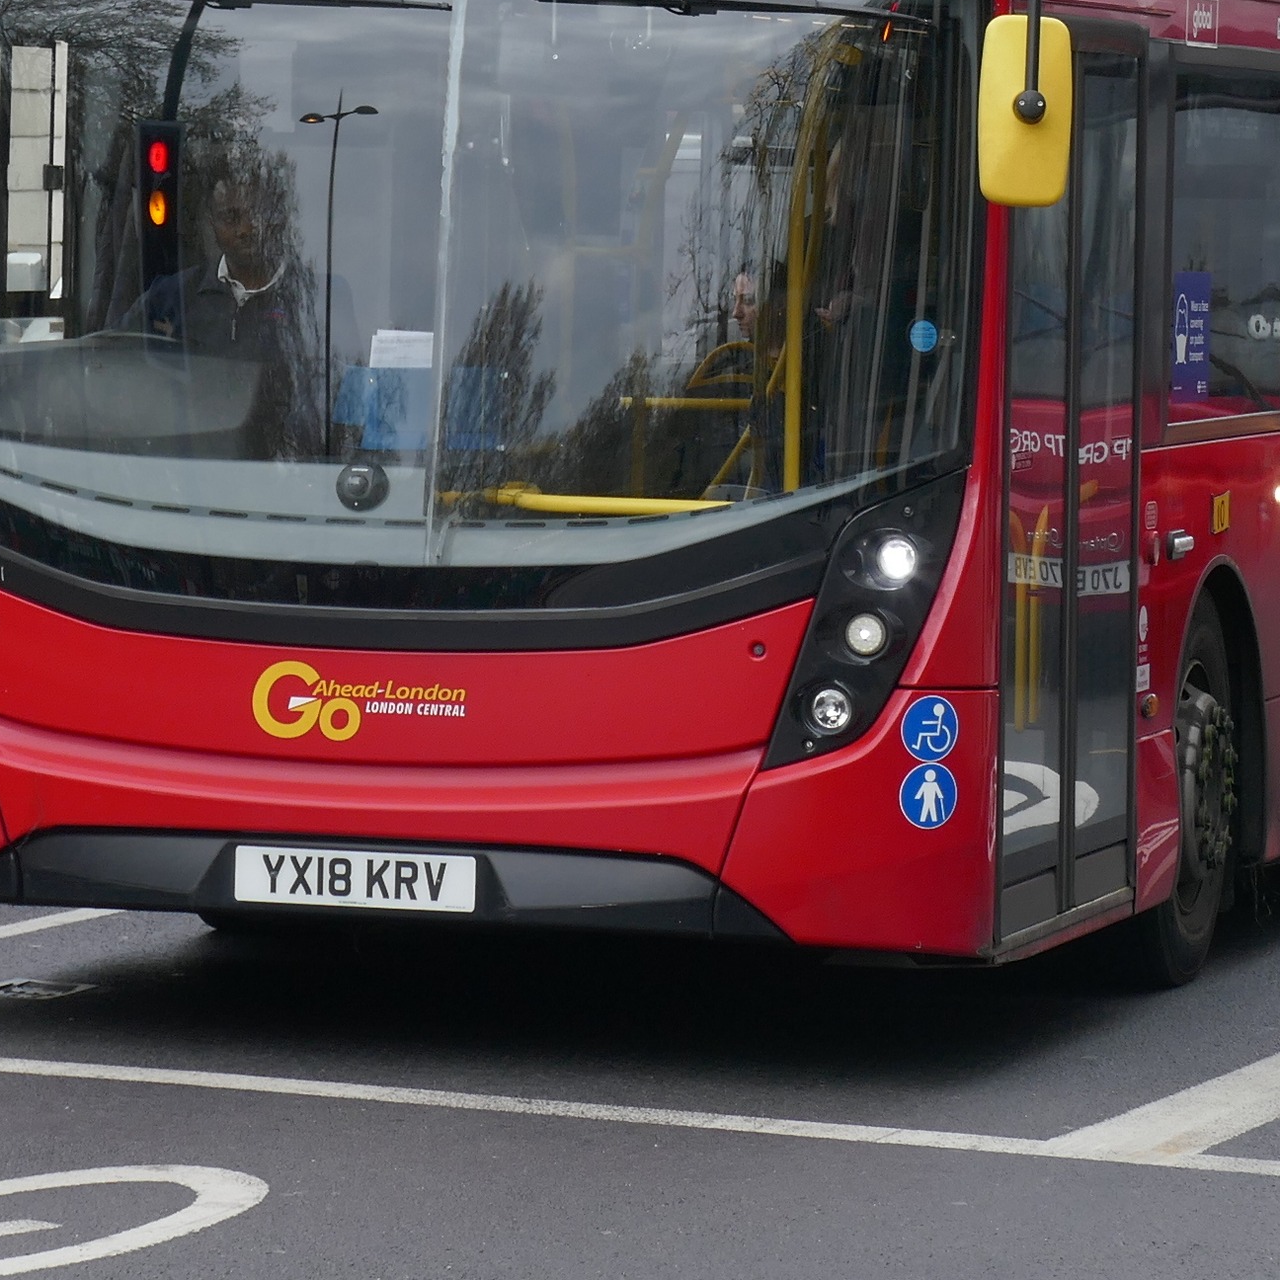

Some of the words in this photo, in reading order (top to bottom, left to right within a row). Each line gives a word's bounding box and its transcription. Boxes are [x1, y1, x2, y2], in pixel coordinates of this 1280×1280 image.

[1193, 2, 1213, 39] global
[252, 660, 362, 742] Go
[312, 679, 466, 702] Ahead-London
[365, 701, 413, 715] LONDON
[416, 703, 466, 717] CENTRAL
[262, 853, 353, 898] YX18
[366, 858, 448, 902] KRV
